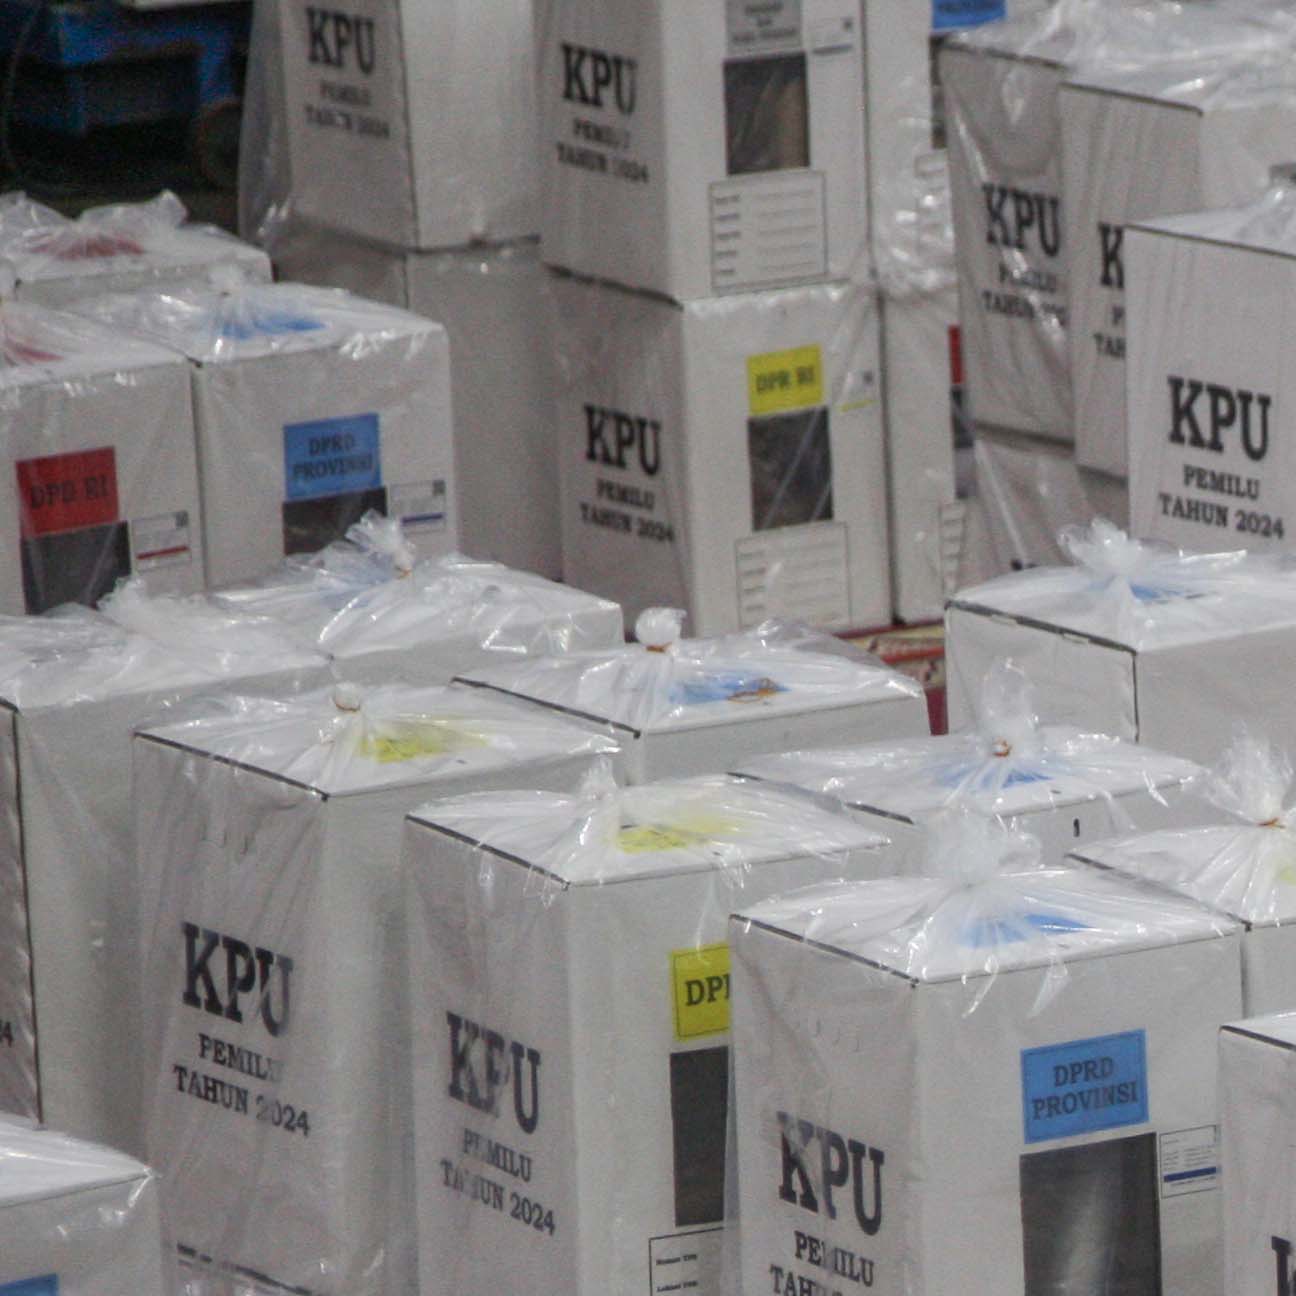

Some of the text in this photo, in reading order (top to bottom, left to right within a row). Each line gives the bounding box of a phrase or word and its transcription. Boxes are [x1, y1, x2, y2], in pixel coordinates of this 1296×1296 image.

[306, 8, 375, 74] KPU
[561, 42, 637, 115] KPU
[983, 183, 1059, 257] KPU
[584, 404, 661, 475] KPU
[1168, 376, 1271, 461] KPU
[1159, 495, 1284, 538] TAHUN 2024
[1184, 465, 1260, 500] PEMILU
[182, 921, 294, 1038] KPU
[173, 1064, 311, 1137] TAHUN 2024
[446, 1011, 542, 1135] KPU
[1032, 1080, 1138, 1122] PROVINSI
[1053, 1056, 1115, 1087] DPRD
[776, 1111, 885, 1236] KPU
[510, 1192, 556, 1236] 2024
